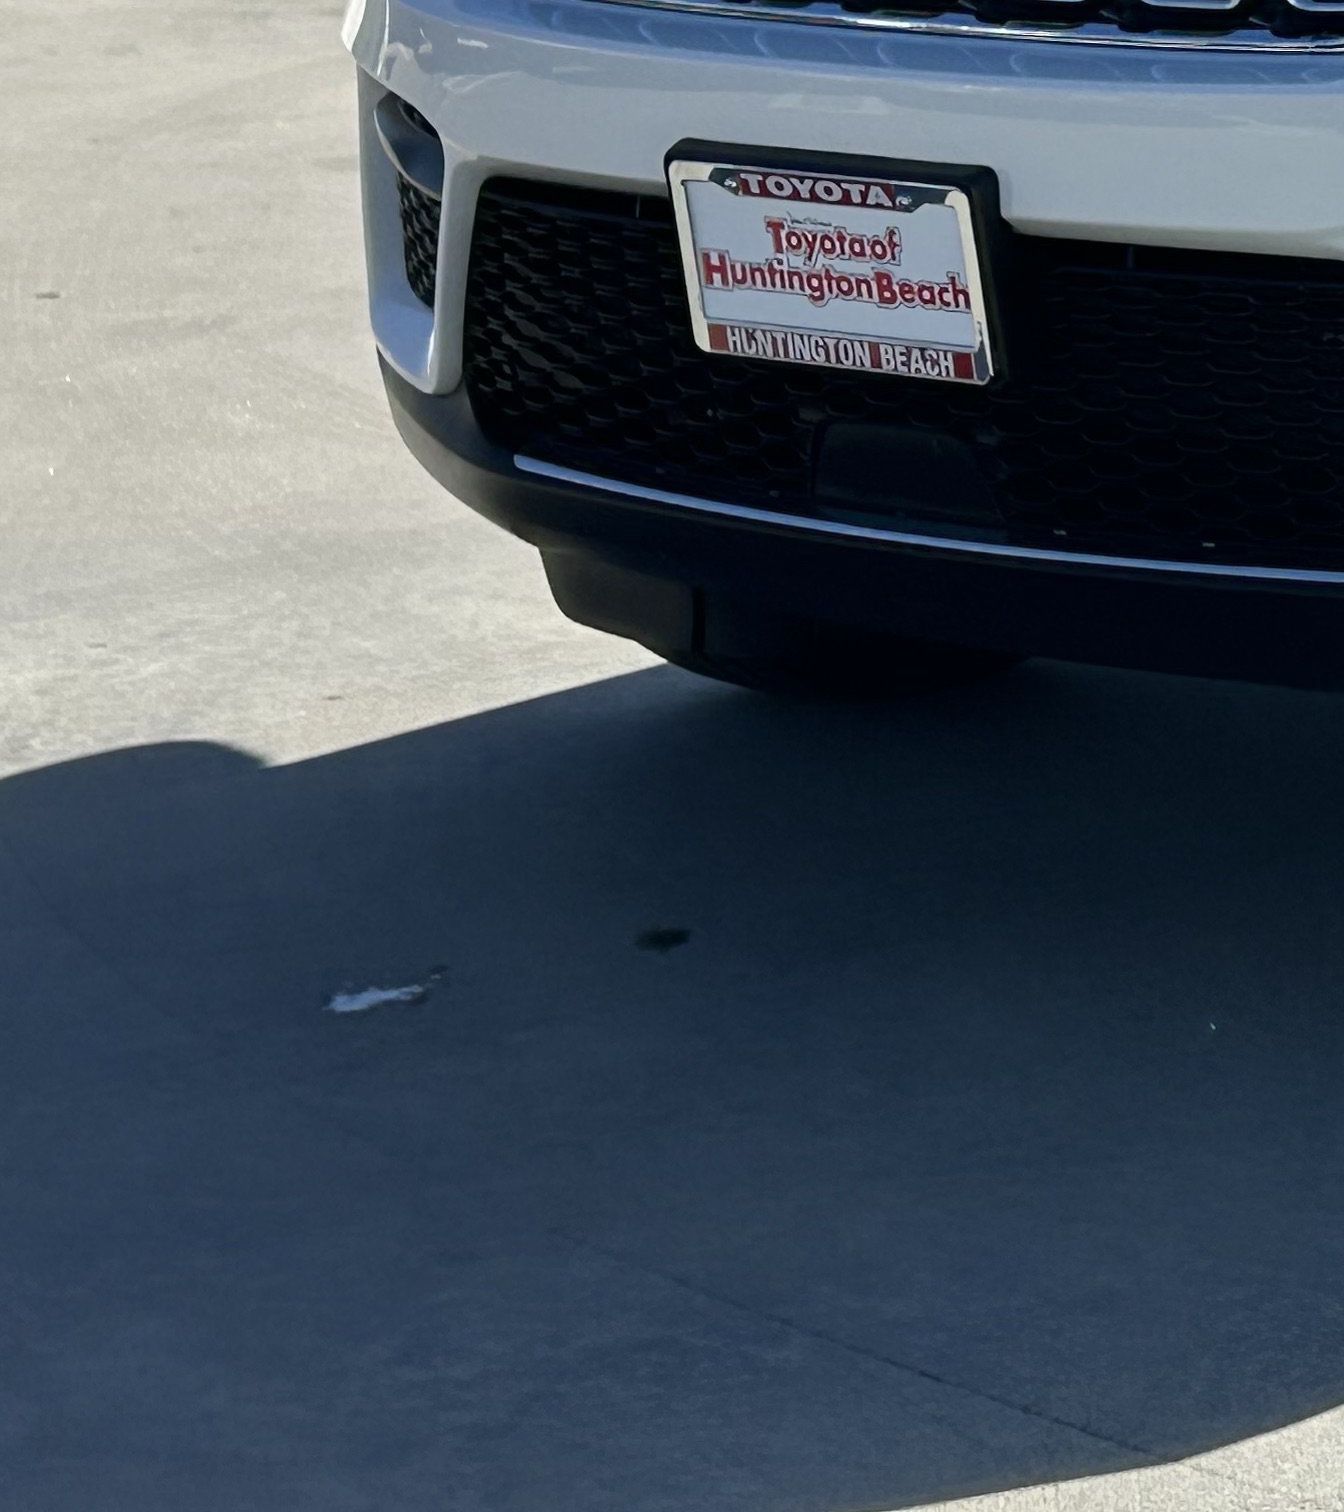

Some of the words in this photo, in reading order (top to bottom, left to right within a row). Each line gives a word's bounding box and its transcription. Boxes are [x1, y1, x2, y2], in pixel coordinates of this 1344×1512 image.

[740, 173, 894, 208] TOYOTA
[701, 249, 873, 304] Huntington
[873, 267, 971, 311] Beach
[727, 325, 871, 368] HUNTINGTON
[881, 344, 955, 379] BEACH
